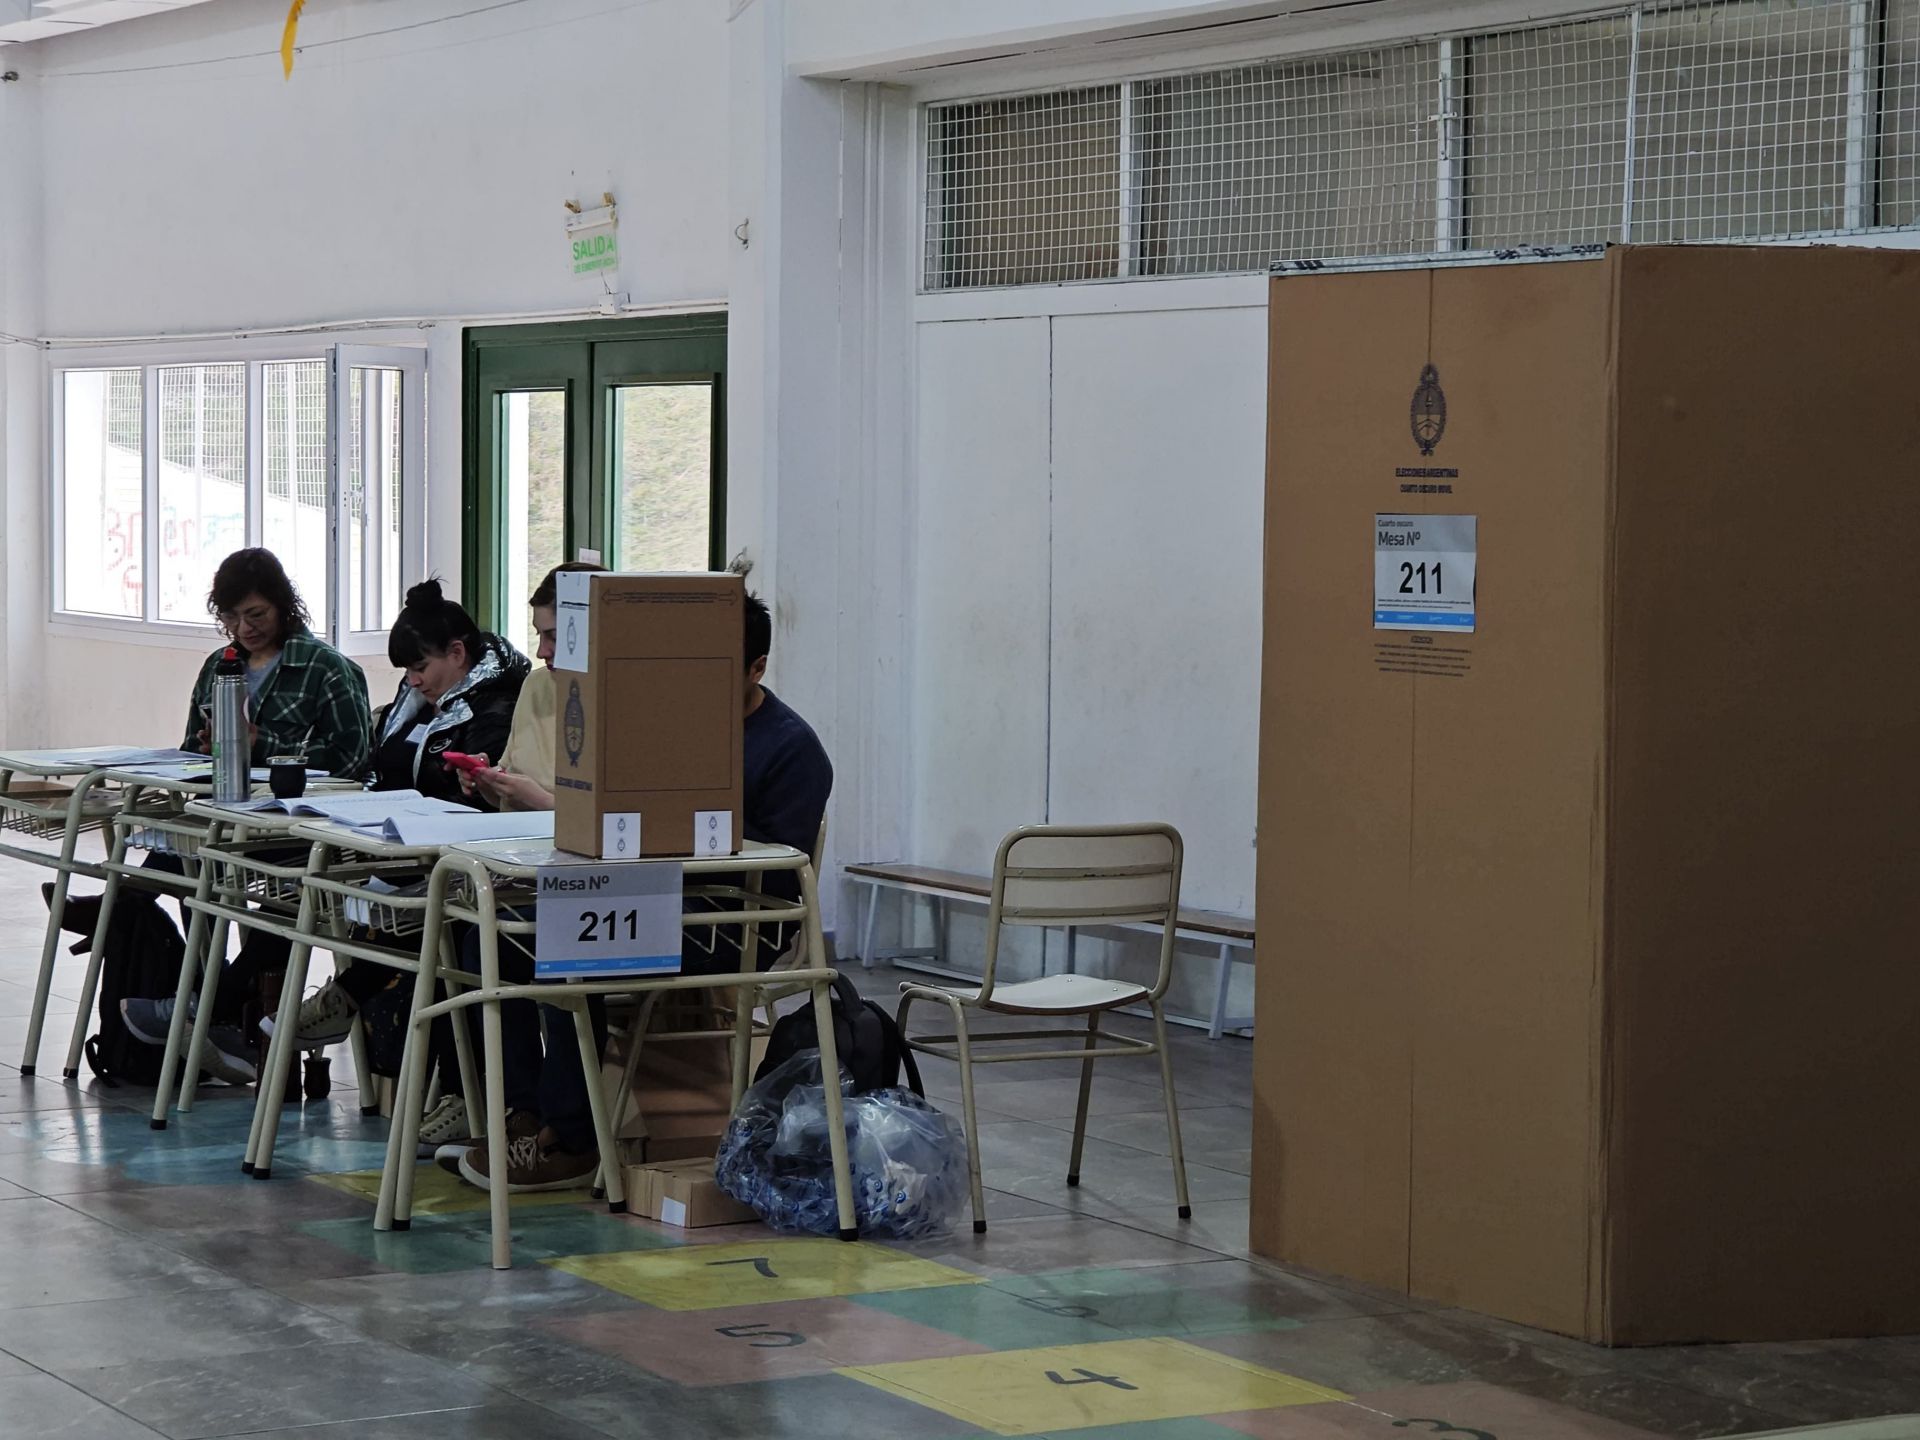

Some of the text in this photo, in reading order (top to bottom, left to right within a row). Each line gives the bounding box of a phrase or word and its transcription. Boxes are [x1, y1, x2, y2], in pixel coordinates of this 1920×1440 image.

[572, 235, 614, 261] SALIDA
[1378, 519, 1396, 527] Cuarto
[1378, 531, 1421, 546] Mesa Nº
[1399, 561, 1442, 595] 211
[543, 875, 610, 891] Mesa Nº
[578, 909, 638, 942] 211
[706, 1257, 779, 1278] 7
[714, 1323, 806, 1348] 5
[1045, 1368, 1139, 1390] 4
